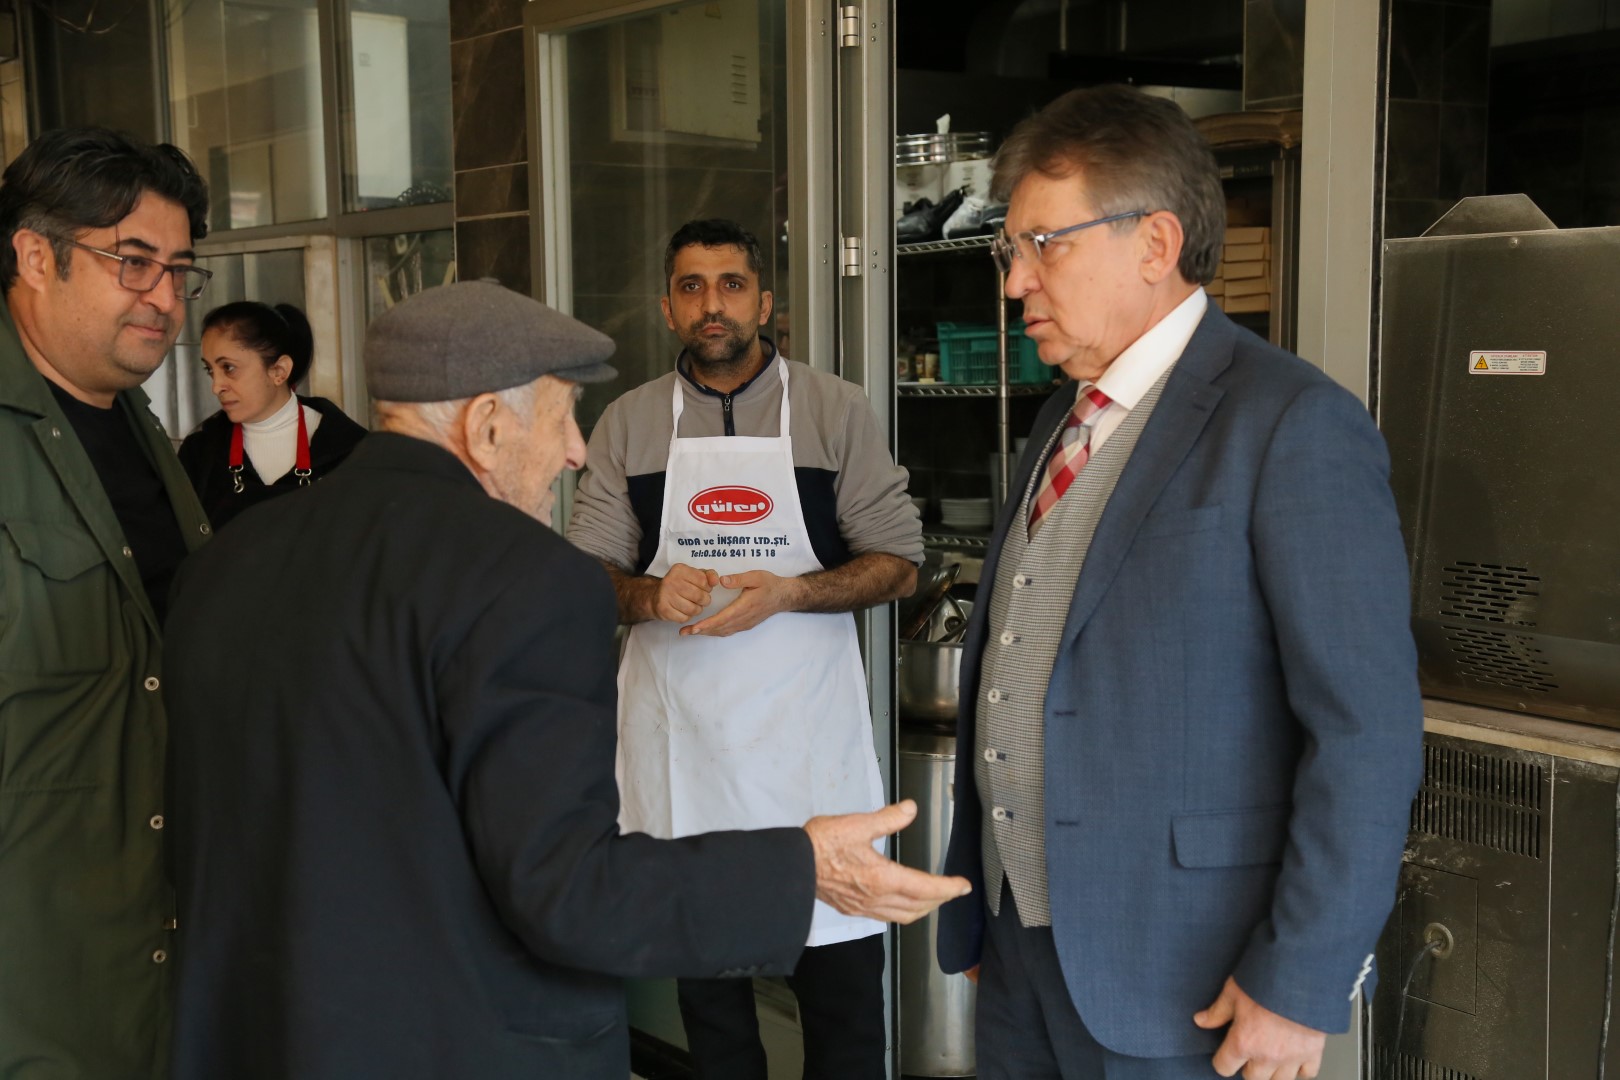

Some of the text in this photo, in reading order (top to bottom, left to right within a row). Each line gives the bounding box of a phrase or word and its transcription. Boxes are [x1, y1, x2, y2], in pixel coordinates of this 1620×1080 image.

[677, 534, 790, 547] GIDA ve İNŞAAT LTD.ŞTİ.
[691, 549, 776, 558] Tel:0.266 241 15 18
